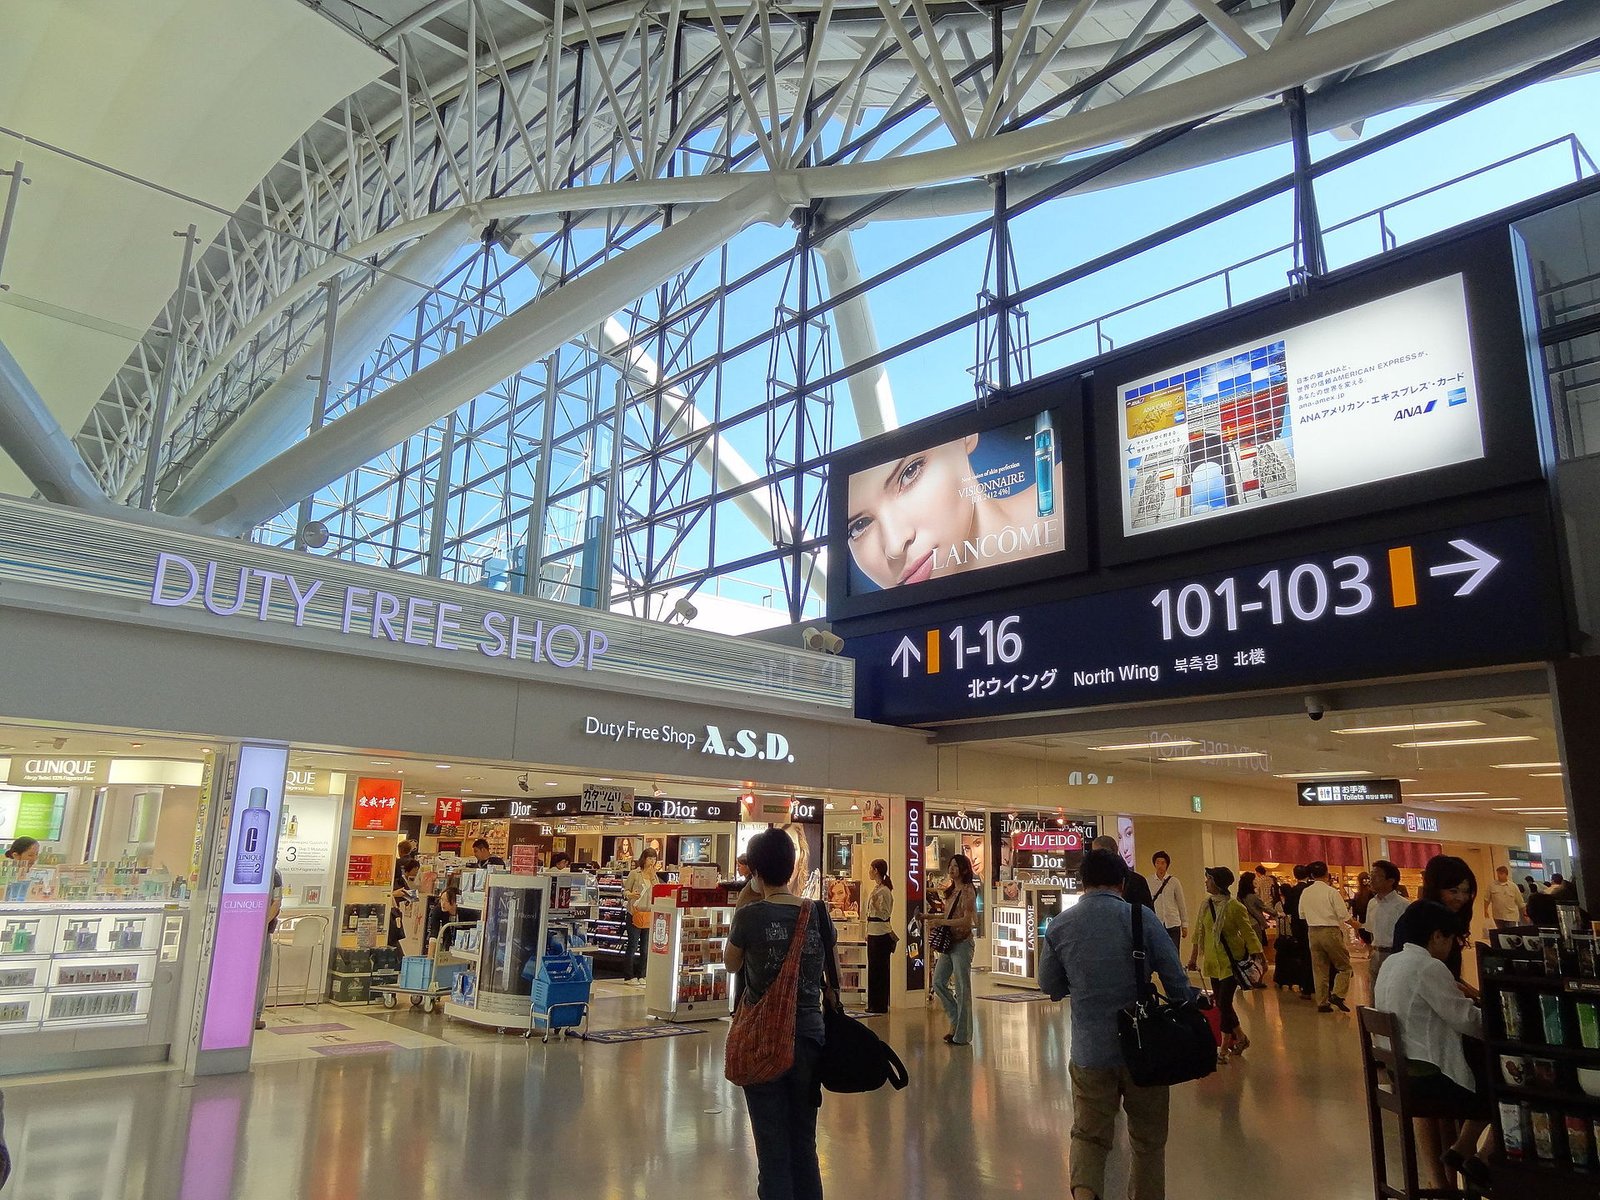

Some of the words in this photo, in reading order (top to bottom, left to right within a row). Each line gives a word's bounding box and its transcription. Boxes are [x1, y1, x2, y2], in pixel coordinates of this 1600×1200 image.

[1393, 404, 1422, 421] ANA
[999, 462, 1021, 474] perfection
[958, 471, 1026, 499] VISIONNAIRE
[932, 519, 1059, 570] LANCÔME
[1151, 555, 1373, 641] 101-103
[151, 552, 324, 627] DUTY
[341, 586, 462, 650] FREE
[478, 611, 609, 671] SHOP
[948, 615, 1023, 670] 1-16
[1174, 653, 1219, 674] 북측윙
[1073, 667, 1115, 687] North
[1118, 662, 1160, 684] Wing
[968, 668, 1058, 699] 北ウイング
[585, 716, 625, 741] Duty
[626, 720, 659, 740] Free
[662, 725, 696, 749] Shop
[701, 725, 795, 763] A.S.D.
[25, 760, 97, 776] CLINIQUE
[286, 770, 316, 786] QUE
[583, 789, 621, 802] カタツムリ
[1342, 793, 1365, 801] Toilets
[510, 801, 532, 817] Dior
[557, 802, 566, 811] CD
[583, 800, 614, 811] クリーム
[638, 802, 651, 812] CD
[662, 800, 697, 818] Dior
[708, 806, 720, 815] CD
[933, 814, 985, 832] LANCÔME
[1416, 816, 1438, 832] MIYABI
[1018, 833, 1077, 847] SHISEIDO
[286, 846, 297, 862] 3
[908, 808, 920, 892] SHISEIDO
[254, 863, 261, 873] 2
[1032, 854, 1064, 868] Dior
[668, 872, 680, 884] Di
[1027, 875, 1077, 890] ANCÔME
[224, 900, 264, 909] CLINIQUE
